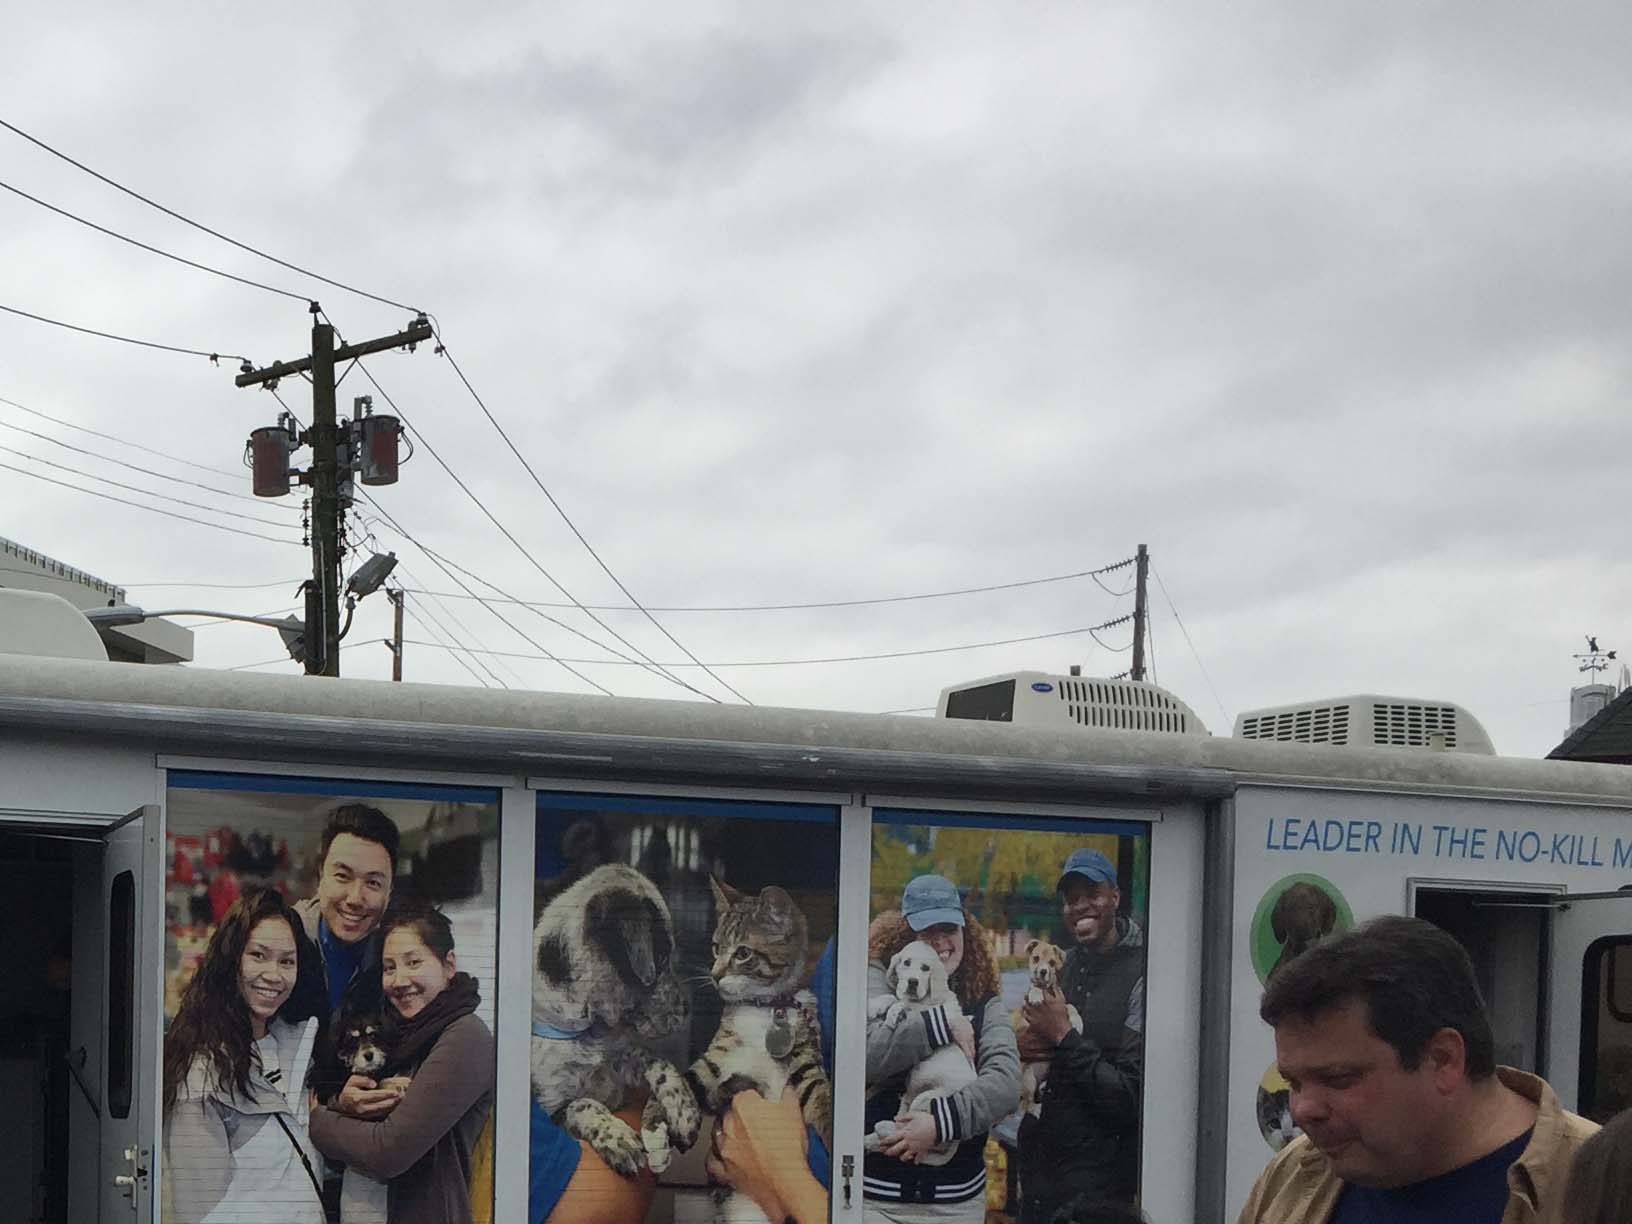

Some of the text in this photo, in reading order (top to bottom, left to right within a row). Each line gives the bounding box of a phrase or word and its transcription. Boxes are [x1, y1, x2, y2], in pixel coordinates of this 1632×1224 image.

[1266, 817, 1382, 853] LEADER
[1391, 821, 1423, 856] IN
[1431, 825, 1488, 860] THE
[1495, 830, 1605, 868] NO-KILL
